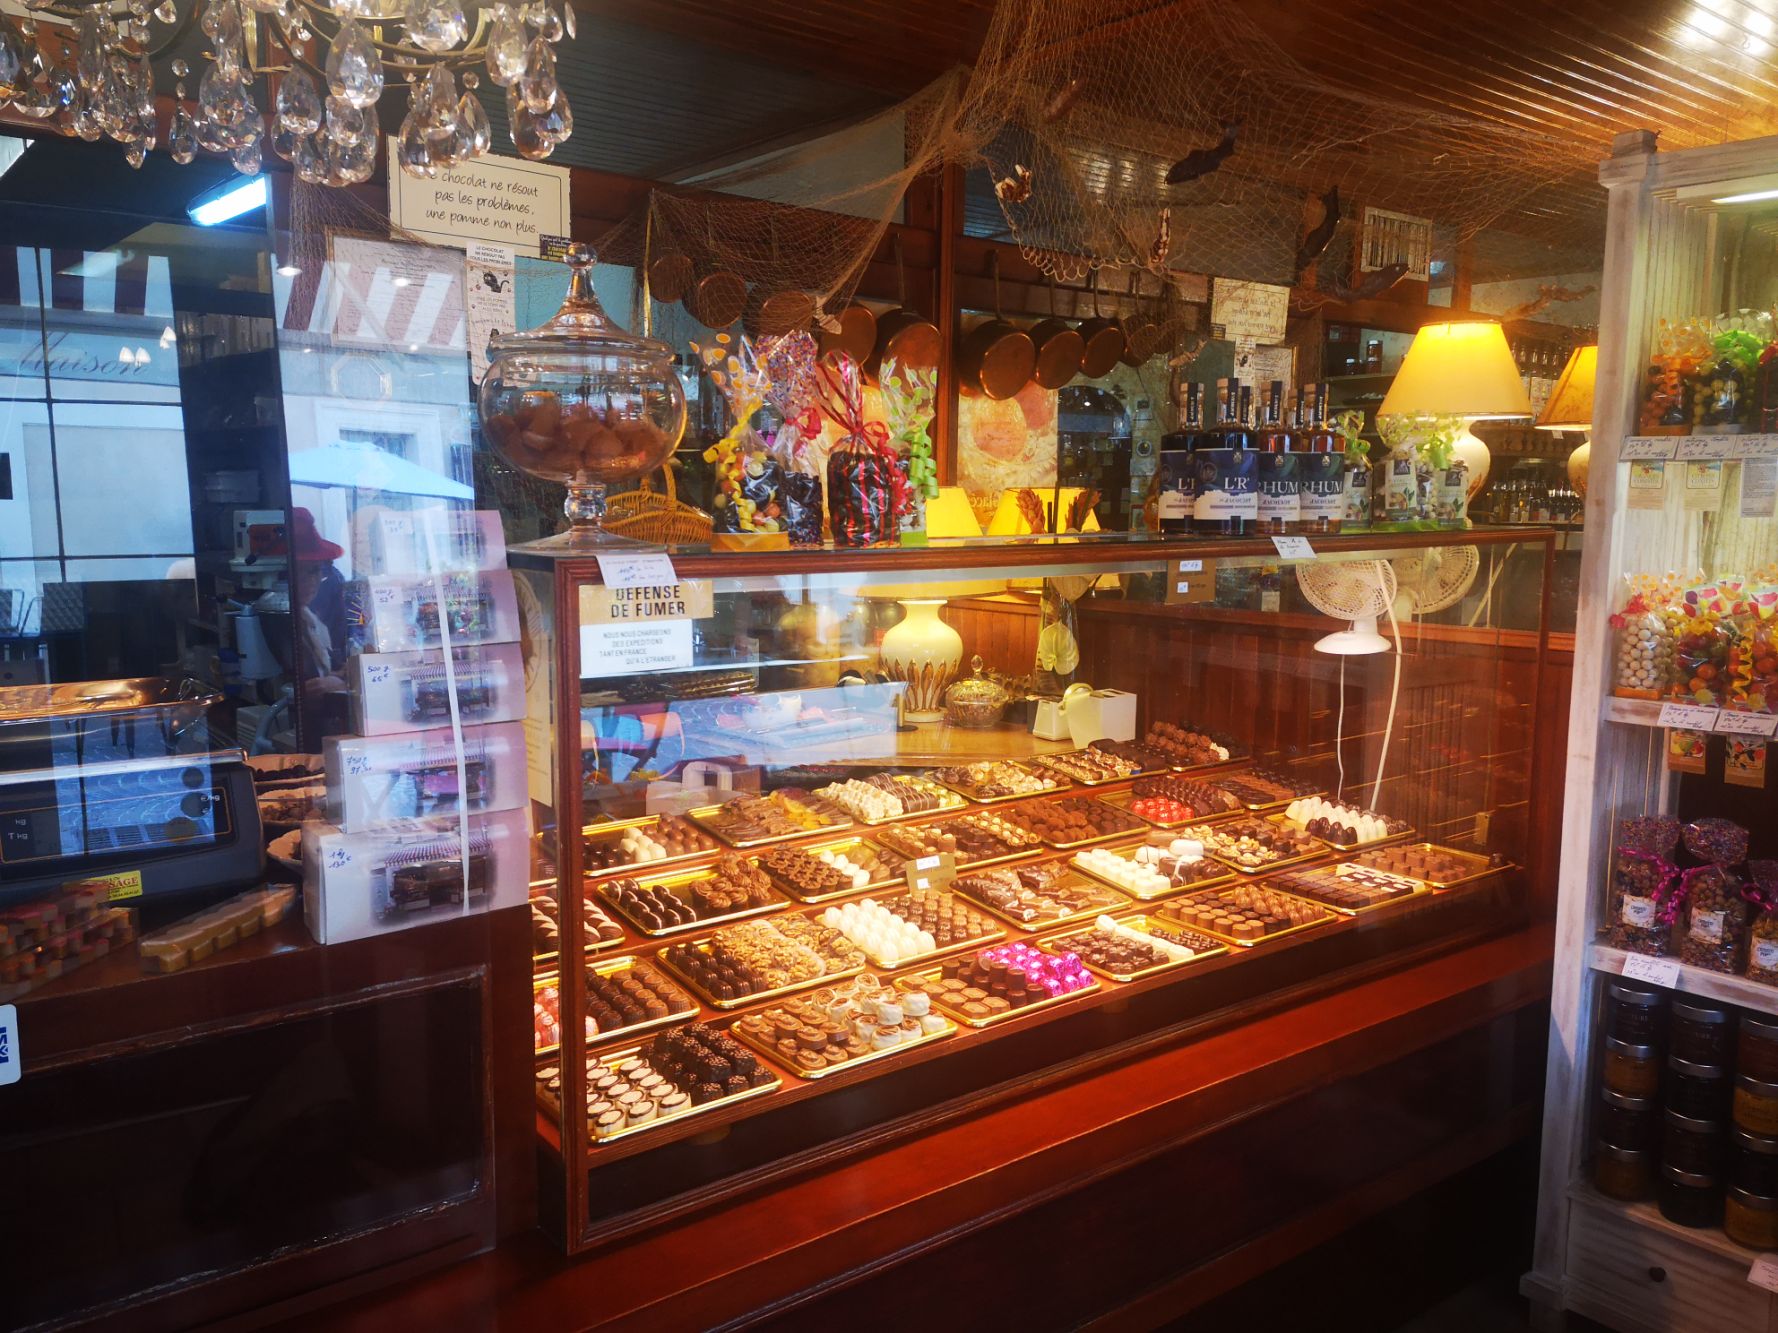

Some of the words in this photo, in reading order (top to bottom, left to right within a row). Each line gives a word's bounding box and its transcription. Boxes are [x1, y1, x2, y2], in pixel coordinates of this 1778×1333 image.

[442, 169, 487, 188] chocolat
[491, 181, 503, 191] ne
[507, 182, 538, 197] résout
[435, 190, 454, 204] pas
[458, 190, 473, 205] les
[425, 209, 446, 220] une
[450, 212, 490, 227] pomme
[494, 220, 512, 230] non
[611, 604, 629, 618] DE
[635, 601, 686, 617] FUMER
[624, 648, 647, 656] FRANCE
